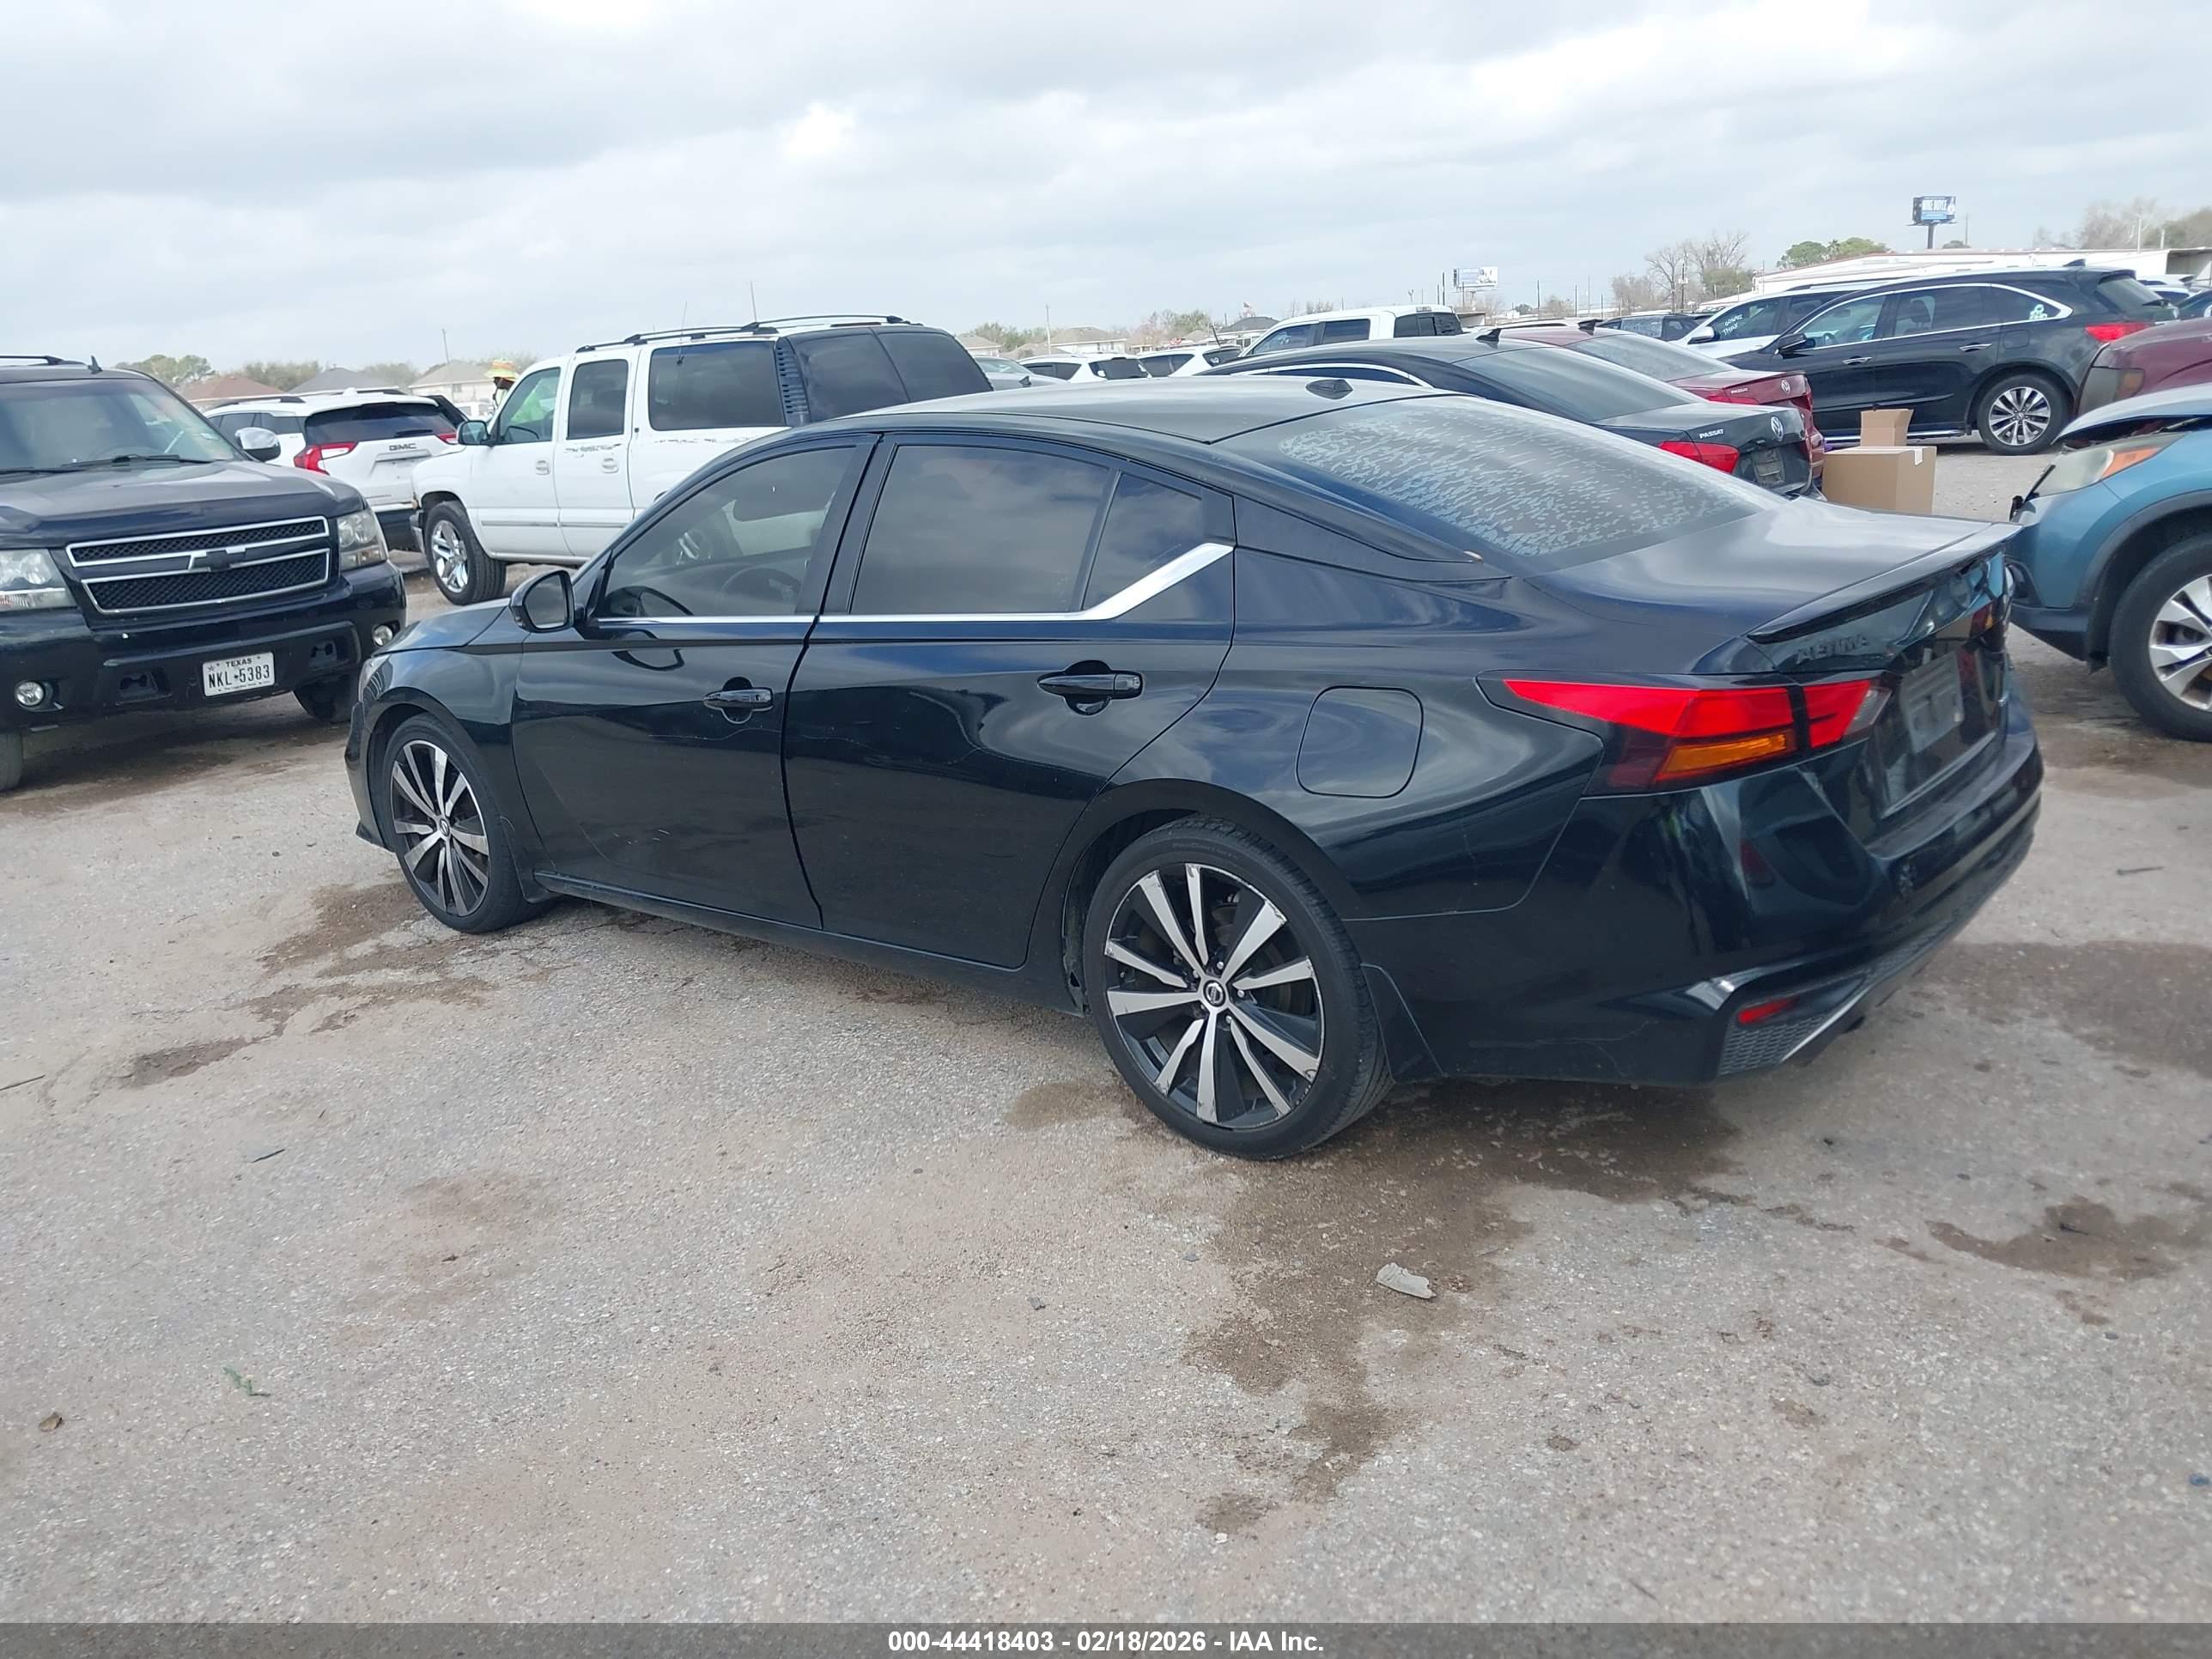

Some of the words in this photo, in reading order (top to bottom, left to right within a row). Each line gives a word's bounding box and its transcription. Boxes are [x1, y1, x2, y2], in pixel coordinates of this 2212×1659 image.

[1699, 428, 1724, 439] PASSAT
[389, 442, 417, 451] GMC
[225, 658, 252, 668] TEXAS
